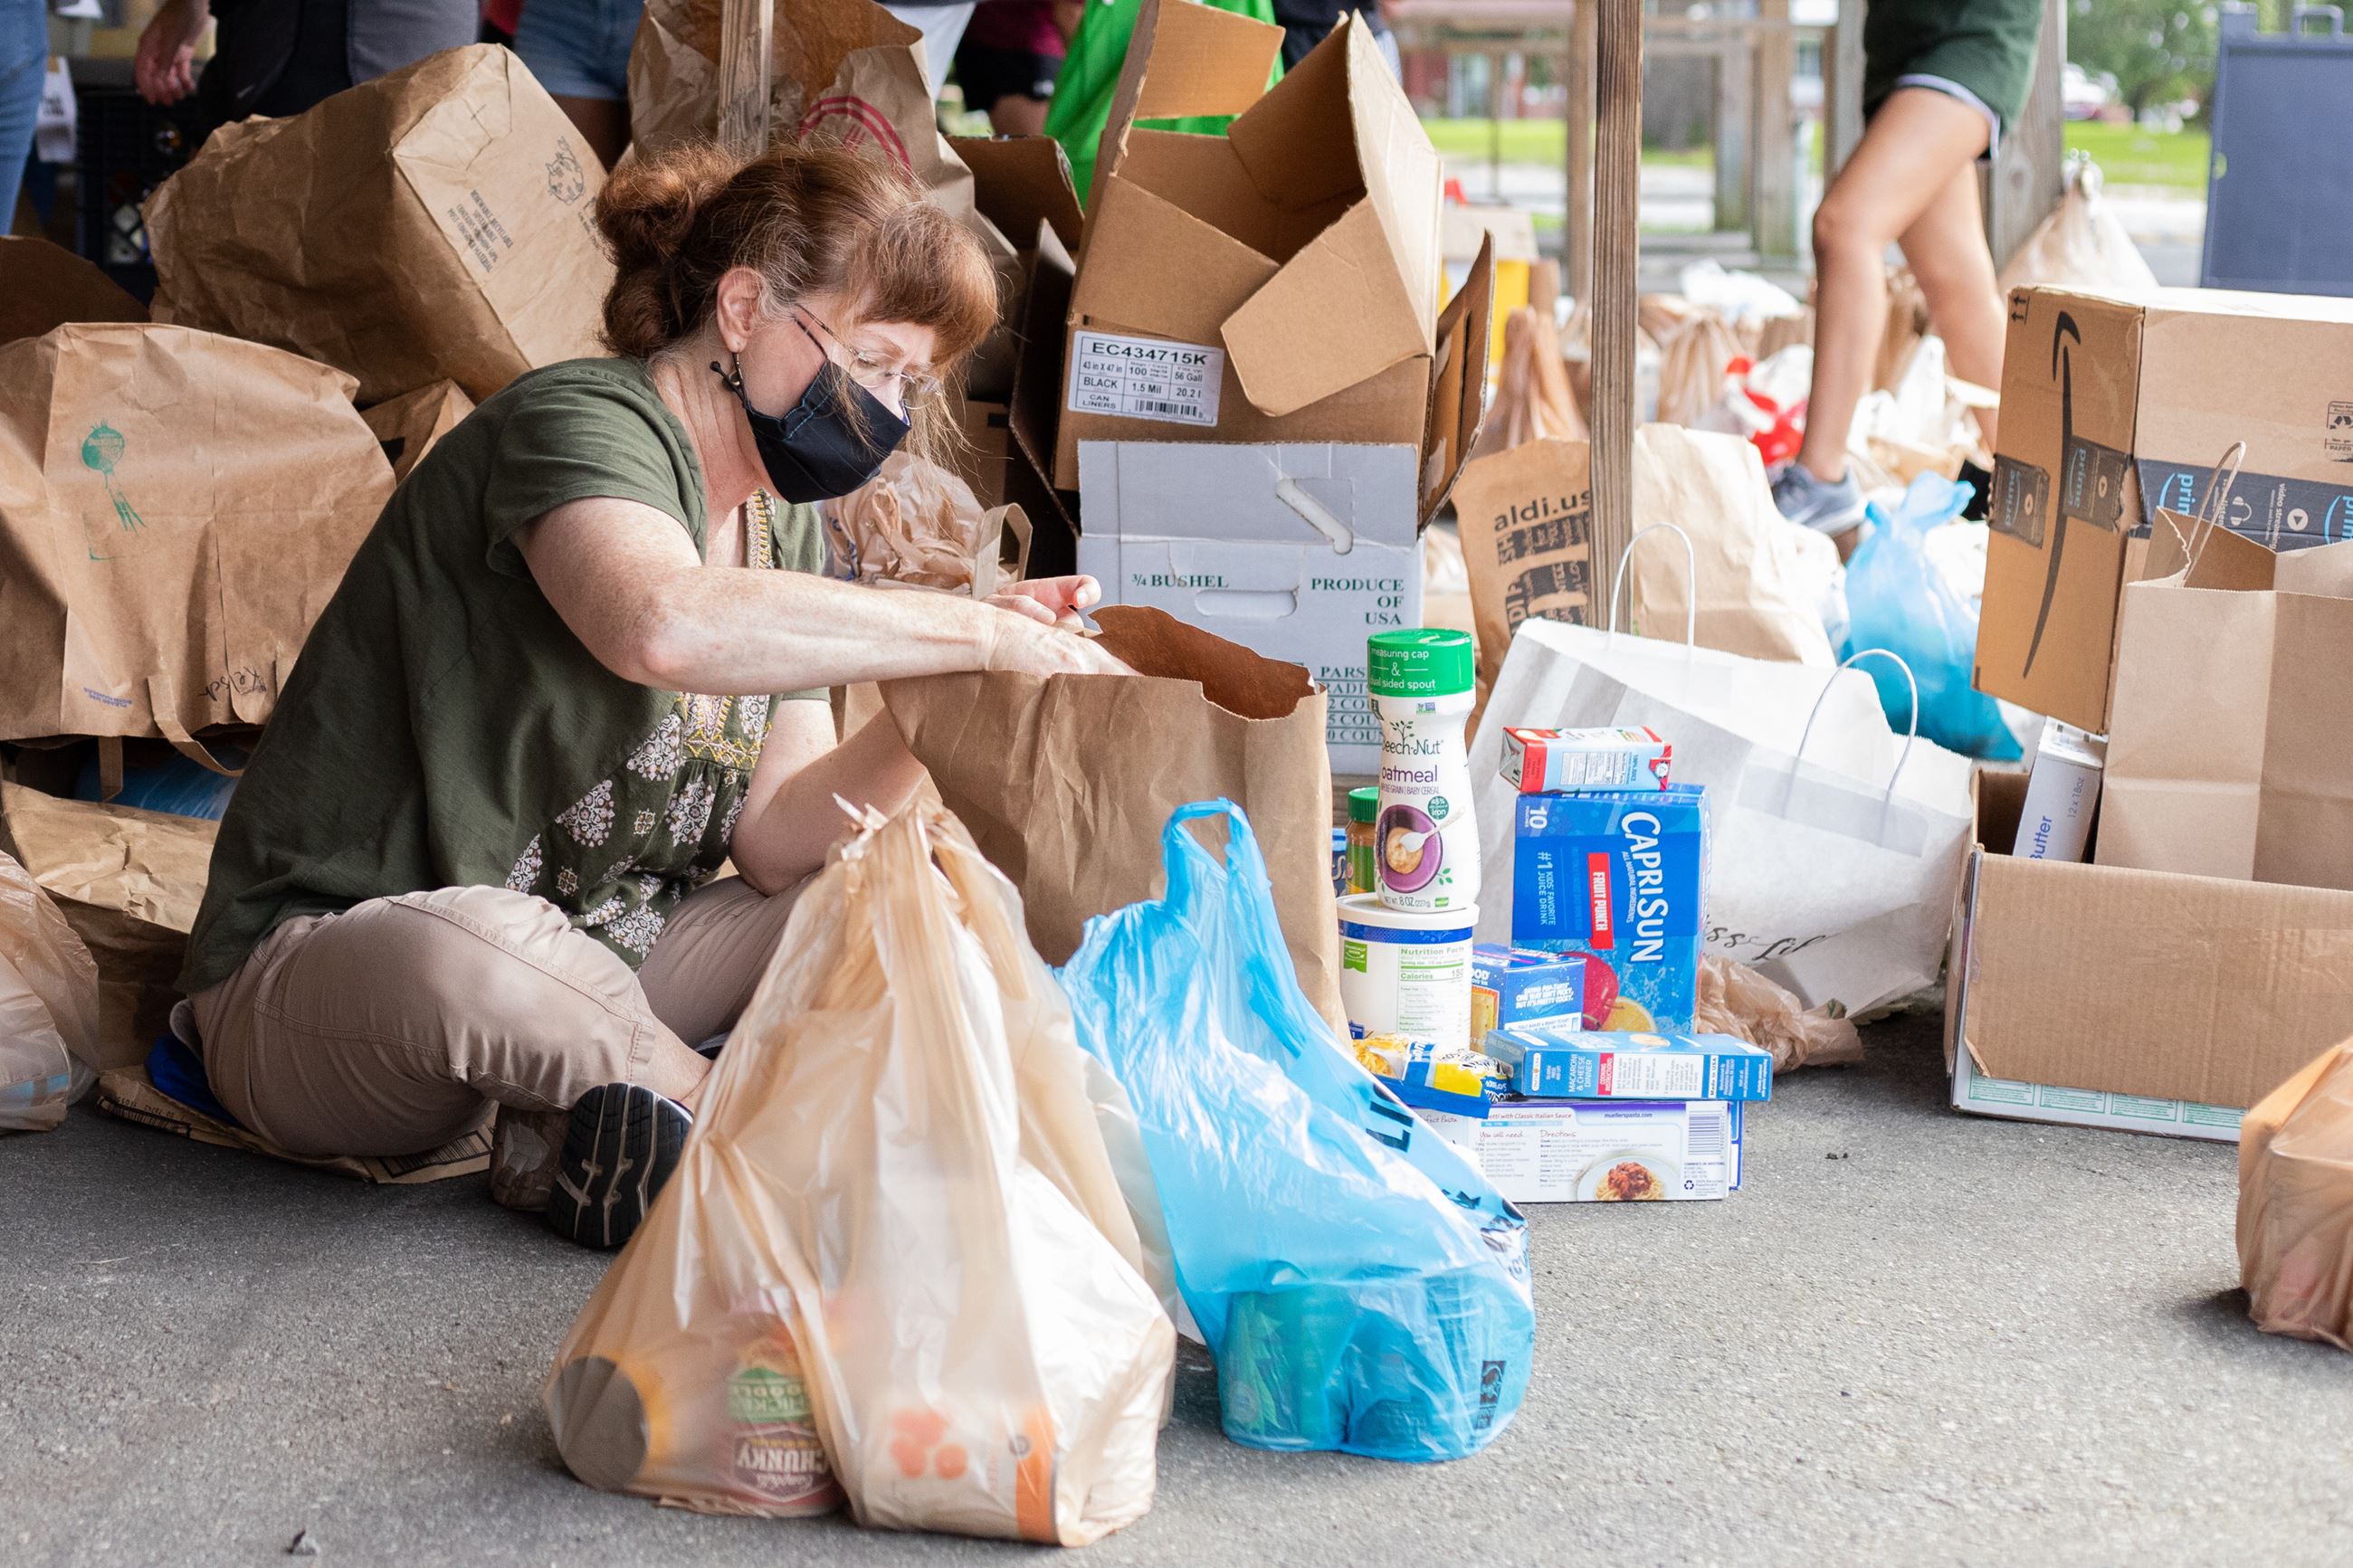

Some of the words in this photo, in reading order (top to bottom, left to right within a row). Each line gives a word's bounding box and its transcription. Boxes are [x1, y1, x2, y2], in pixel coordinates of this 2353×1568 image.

[1092, 342, 1208, 366] EC434715K
[1083, 361, 1092, 369] 43
[1107, 364, 1116, 372] 47
[1129, 366, 1147, 376] 100
[1083, 376, 1118, 389] BLACK
[1175, 371, 1185, 381] 56
[1132, 383, 1145, 393] 1.5
[1148, 384, 1162, 394] Mil
[1176, 387, 1195, 398] 20.2
[1082, 401, 1116, 409] LINERS
[2268, 506, 2282, 550] streaming
[1151, 575, 1229, 588] BUSHEL
[1312, 578, 1405, 592] PRODUCE
[1377, 595, 1403, 608] OF
[1365, 613, 1402, 625] USA
[1412, 651, 1429, 660] cap
[1321, 666, 1366, 678] PARS
[1391, 661, 1401, 676] &
[1382, 679, 1405, 689] sided
[1407, 679, 1436, 692] spout
[1382, 765, 1438, 783] oatmeal
[1391, 784, 1404, 794] GRAIN
[1406, 785, 1420, 794] BABY
[1421, 785, 1440, 795] CEREAL
[1529, 806, 1548, 830] 10
[1537, 851, 1554, 870] #1
[1547, 889, 1556, 926] FAVORITE
[1593, 871, 1606, 898] FRUIT
[1399, 896, 1404, 906] 8
[1405, 897, 1415, 907] OZ
[1539, 898, 1548, 926] DRINK
[1595, 899, 1608, 931] PUNCH
[1568, 1053, 1577, 1093] MACARONI
[1577, 1056, 1586, 1085] CHEESE
[1424, 1115, 1443, 1124] fect
[1480, 1131, 1492, 1141] You
[1540, 1129, 1577, 1138] Directions
